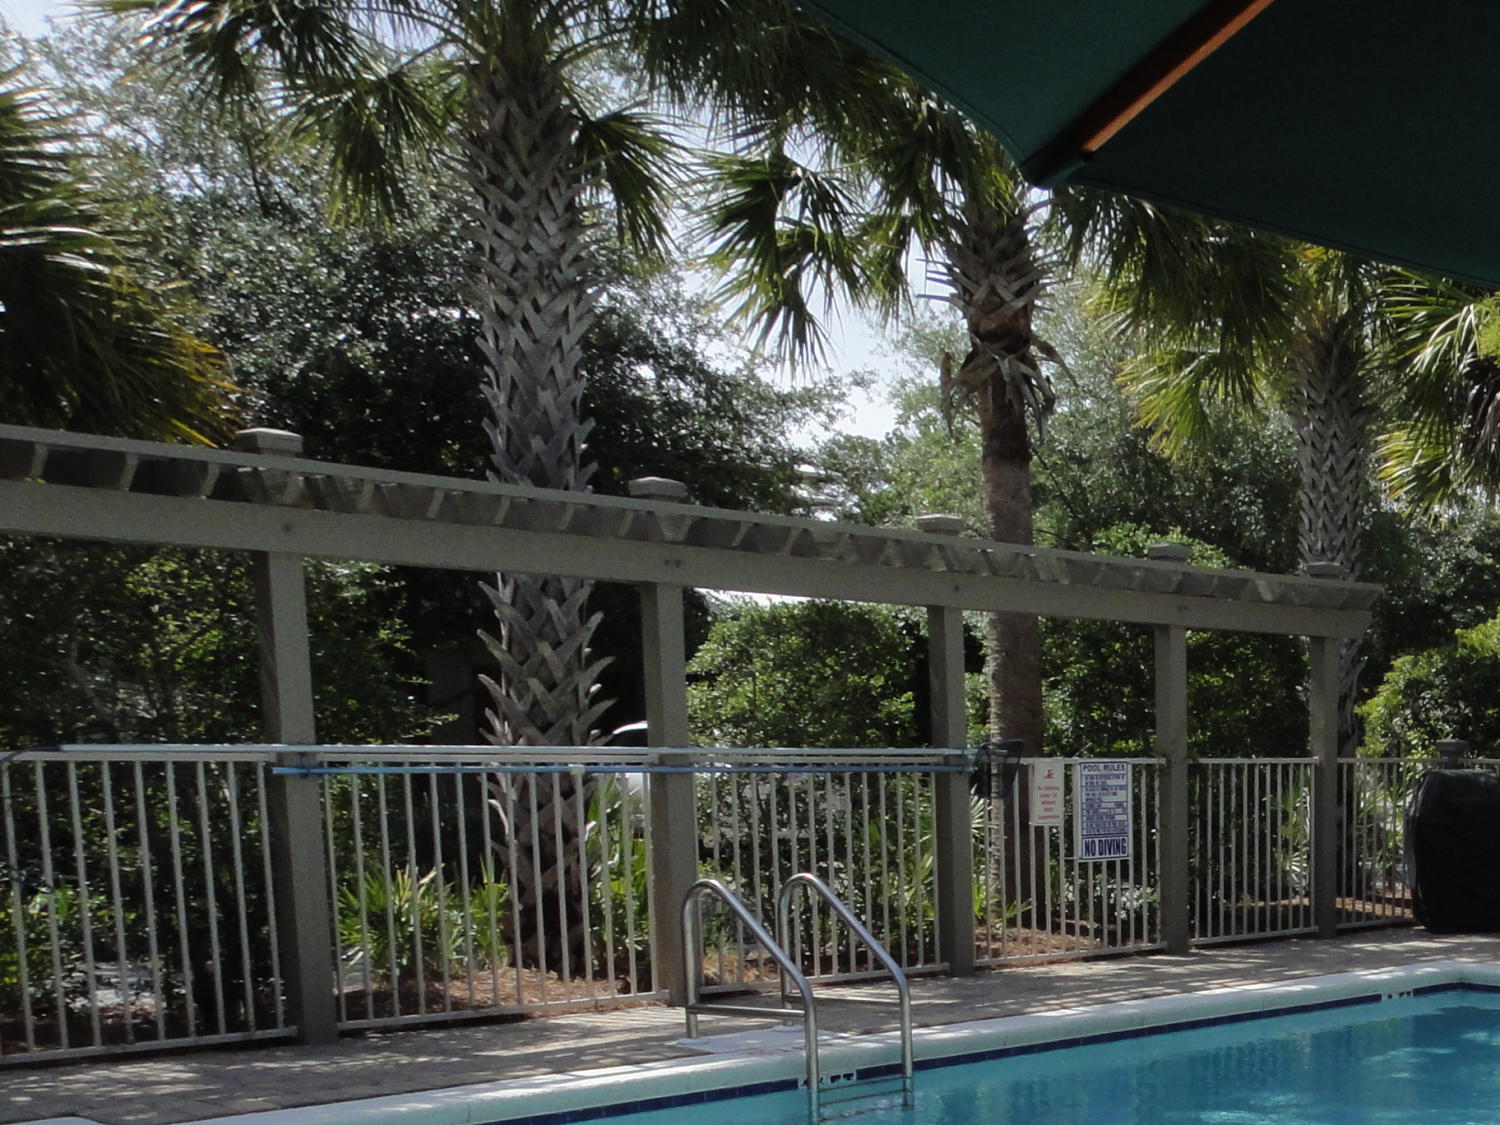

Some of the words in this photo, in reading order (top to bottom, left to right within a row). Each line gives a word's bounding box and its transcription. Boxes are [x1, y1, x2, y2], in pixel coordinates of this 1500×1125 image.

[1083, 764, 1102, 772] POOL
[1103, 763, 1125, 772] RULES
[1084, 839, 1097, 857] NO
[1098, 838, 1127, 856] DIVING
